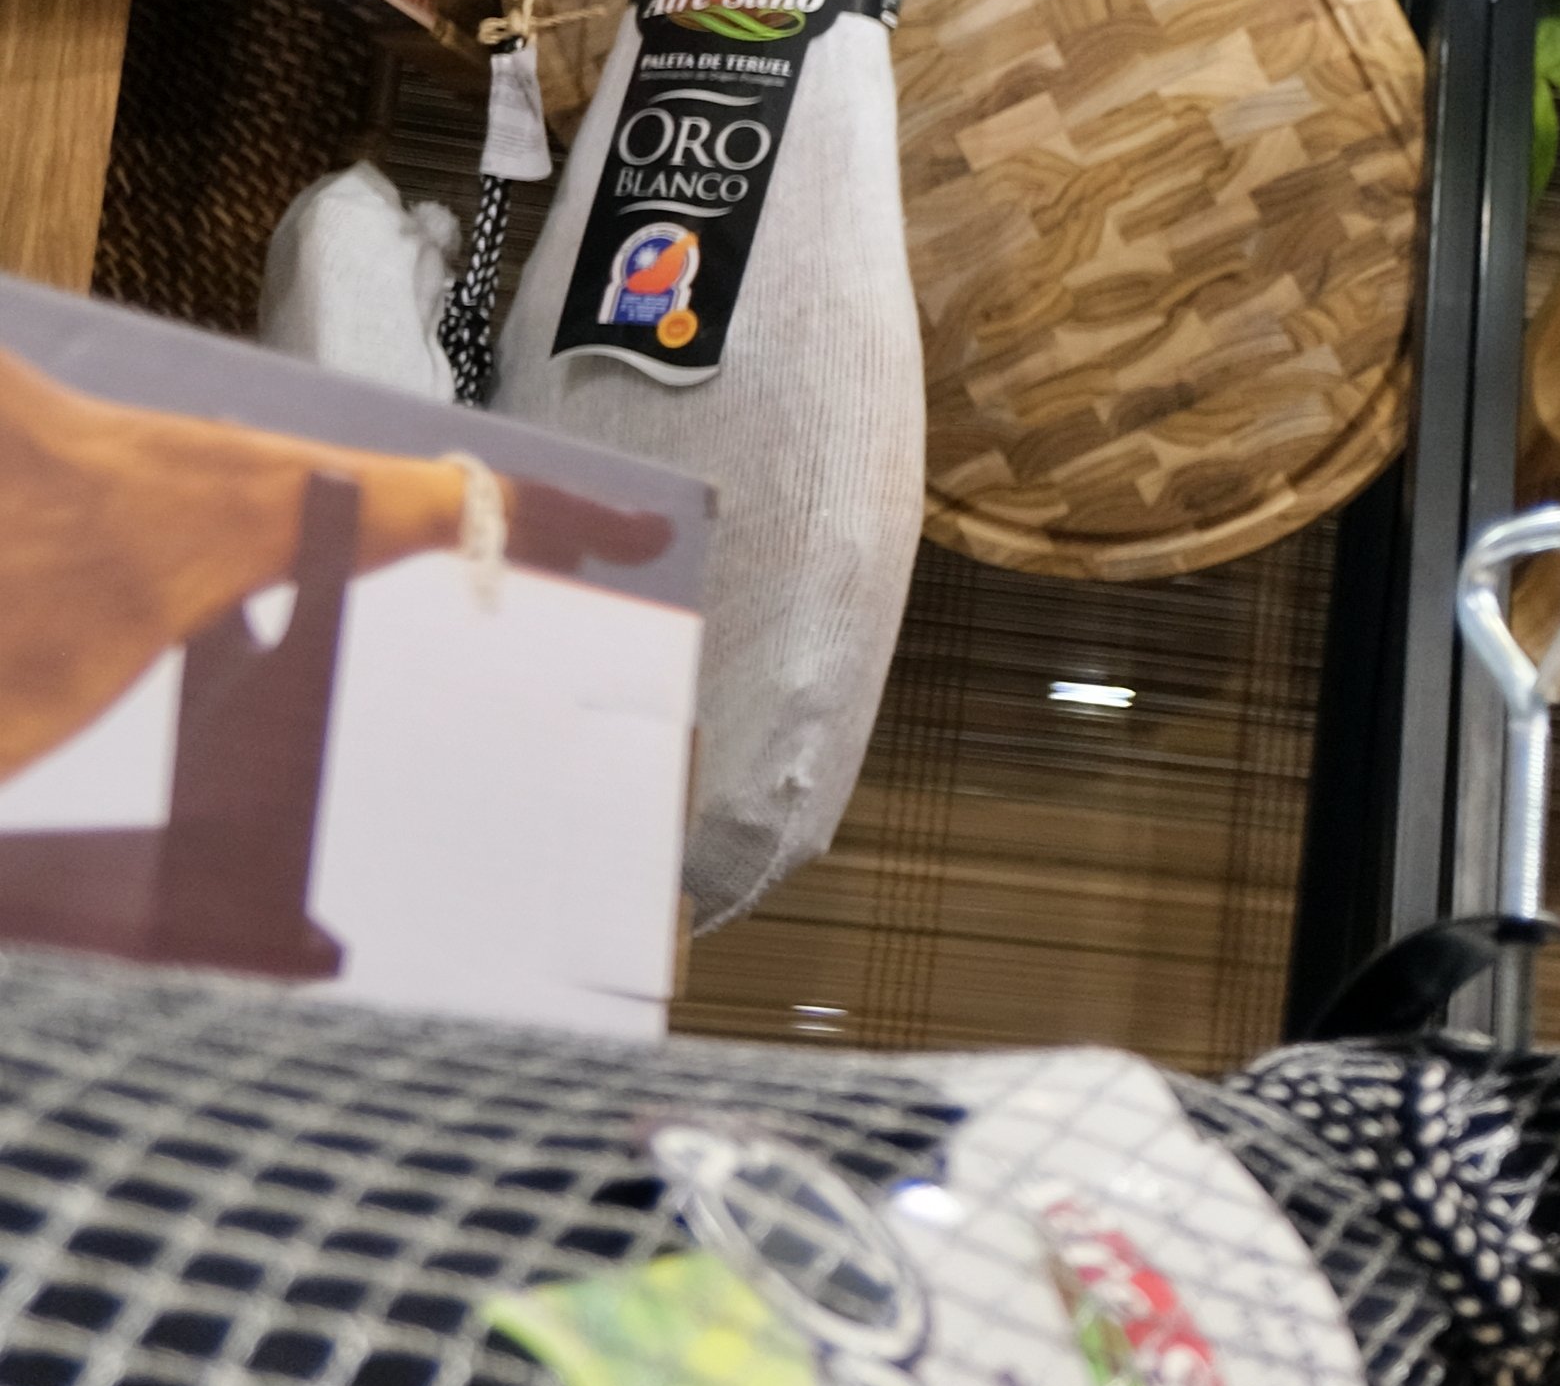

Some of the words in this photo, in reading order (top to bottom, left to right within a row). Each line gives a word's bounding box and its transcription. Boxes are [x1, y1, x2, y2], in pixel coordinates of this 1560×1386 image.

[640, 51, 695, 70] PALETA
[697, 52, 723, 70] DE
[726, 53, 792, 77] TERUEL
[617, 107, 772, 171] ORO
[614, 166, 749, 203] BLANCO
